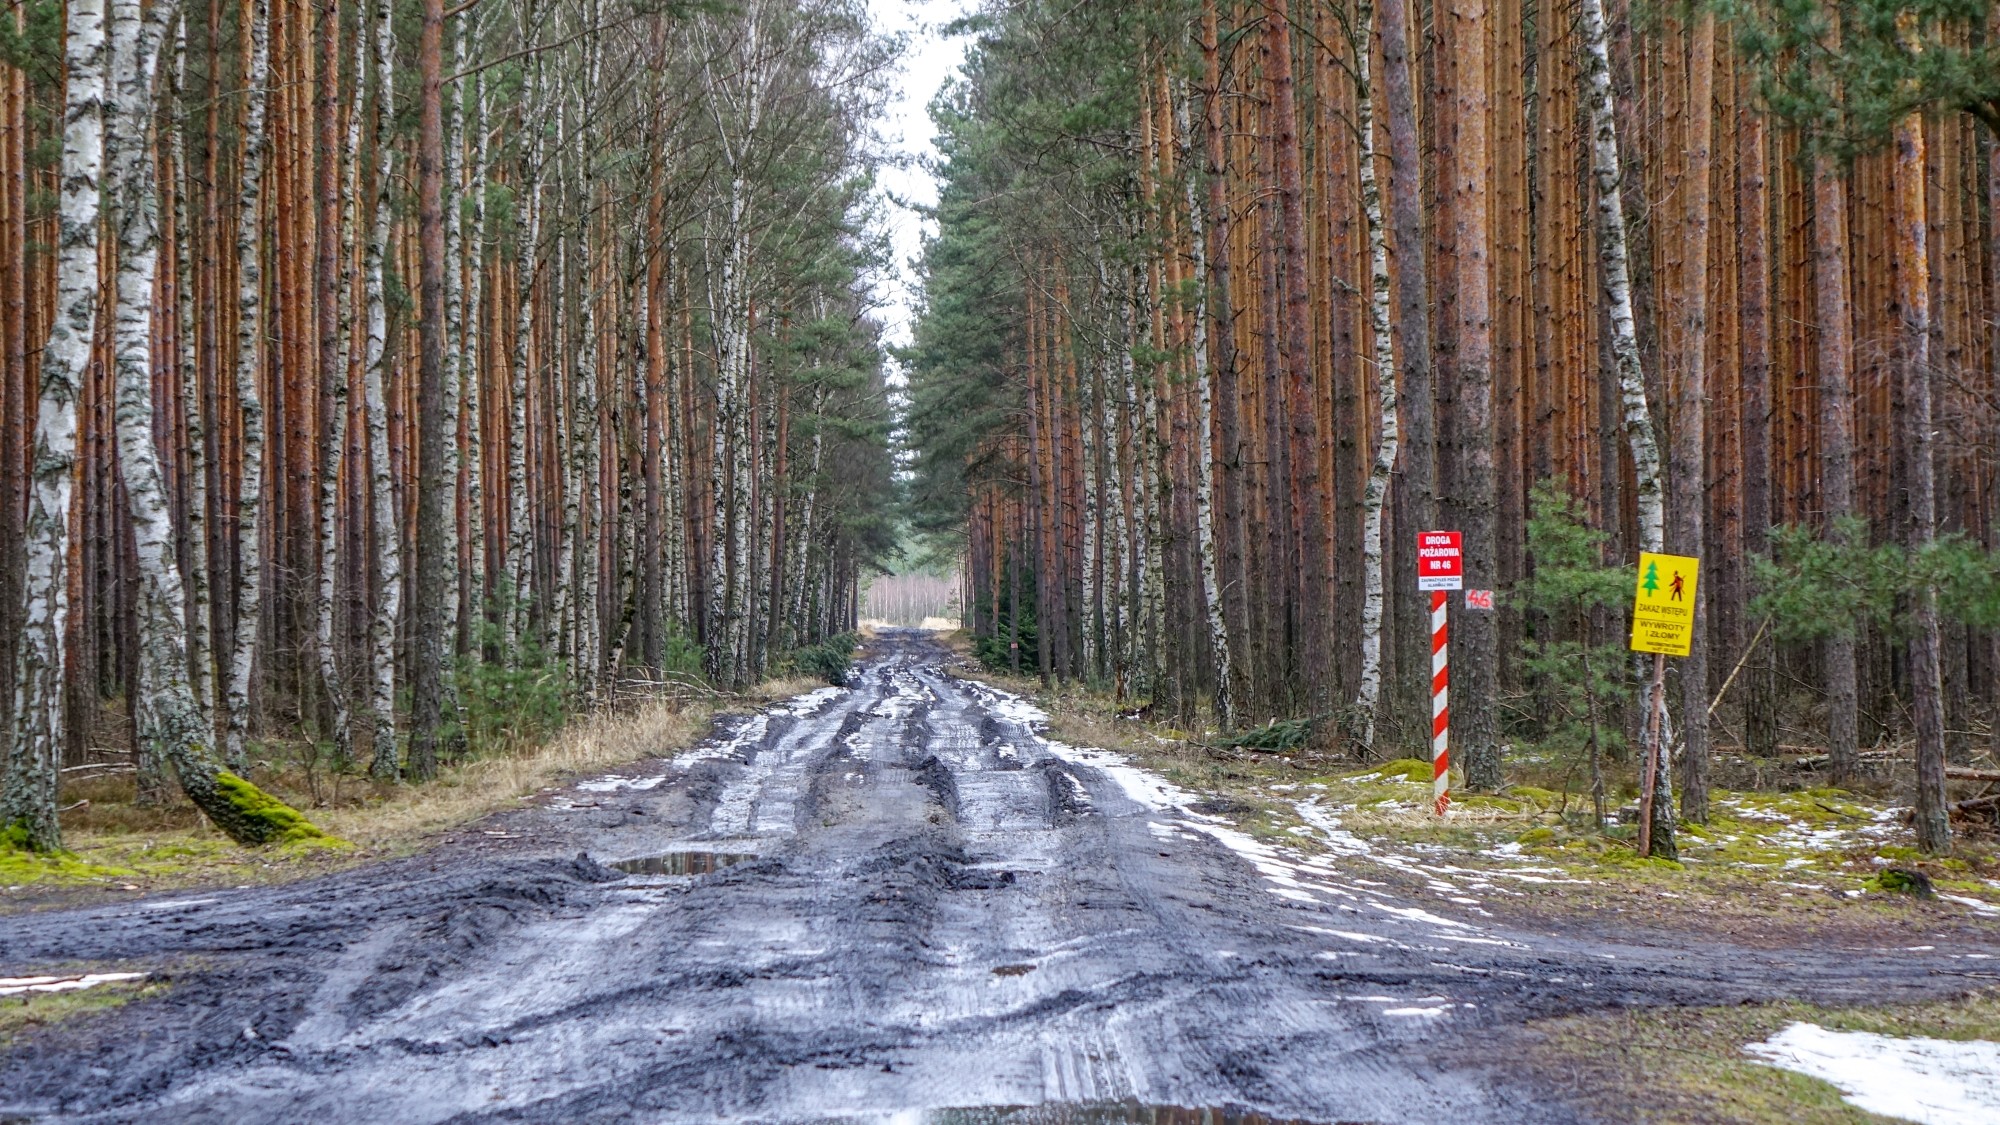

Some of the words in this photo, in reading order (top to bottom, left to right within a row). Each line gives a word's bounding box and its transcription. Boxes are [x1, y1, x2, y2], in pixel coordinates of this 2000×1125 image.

[1425, 536, 1450, 544] DROGA
[1420, 546, 1460, 557] POŻAROWA
[1430, 560, 1441, 570] NR
[1442, 560, 1452, 570] 46
[1467, 589, 1492, 608] 46
[1638, 604, 1660, 613] ZAKAZ
[1640, 621, 1686, 631] WYWROTY
[1650, 630, 1681, 640] ZŁOMY
